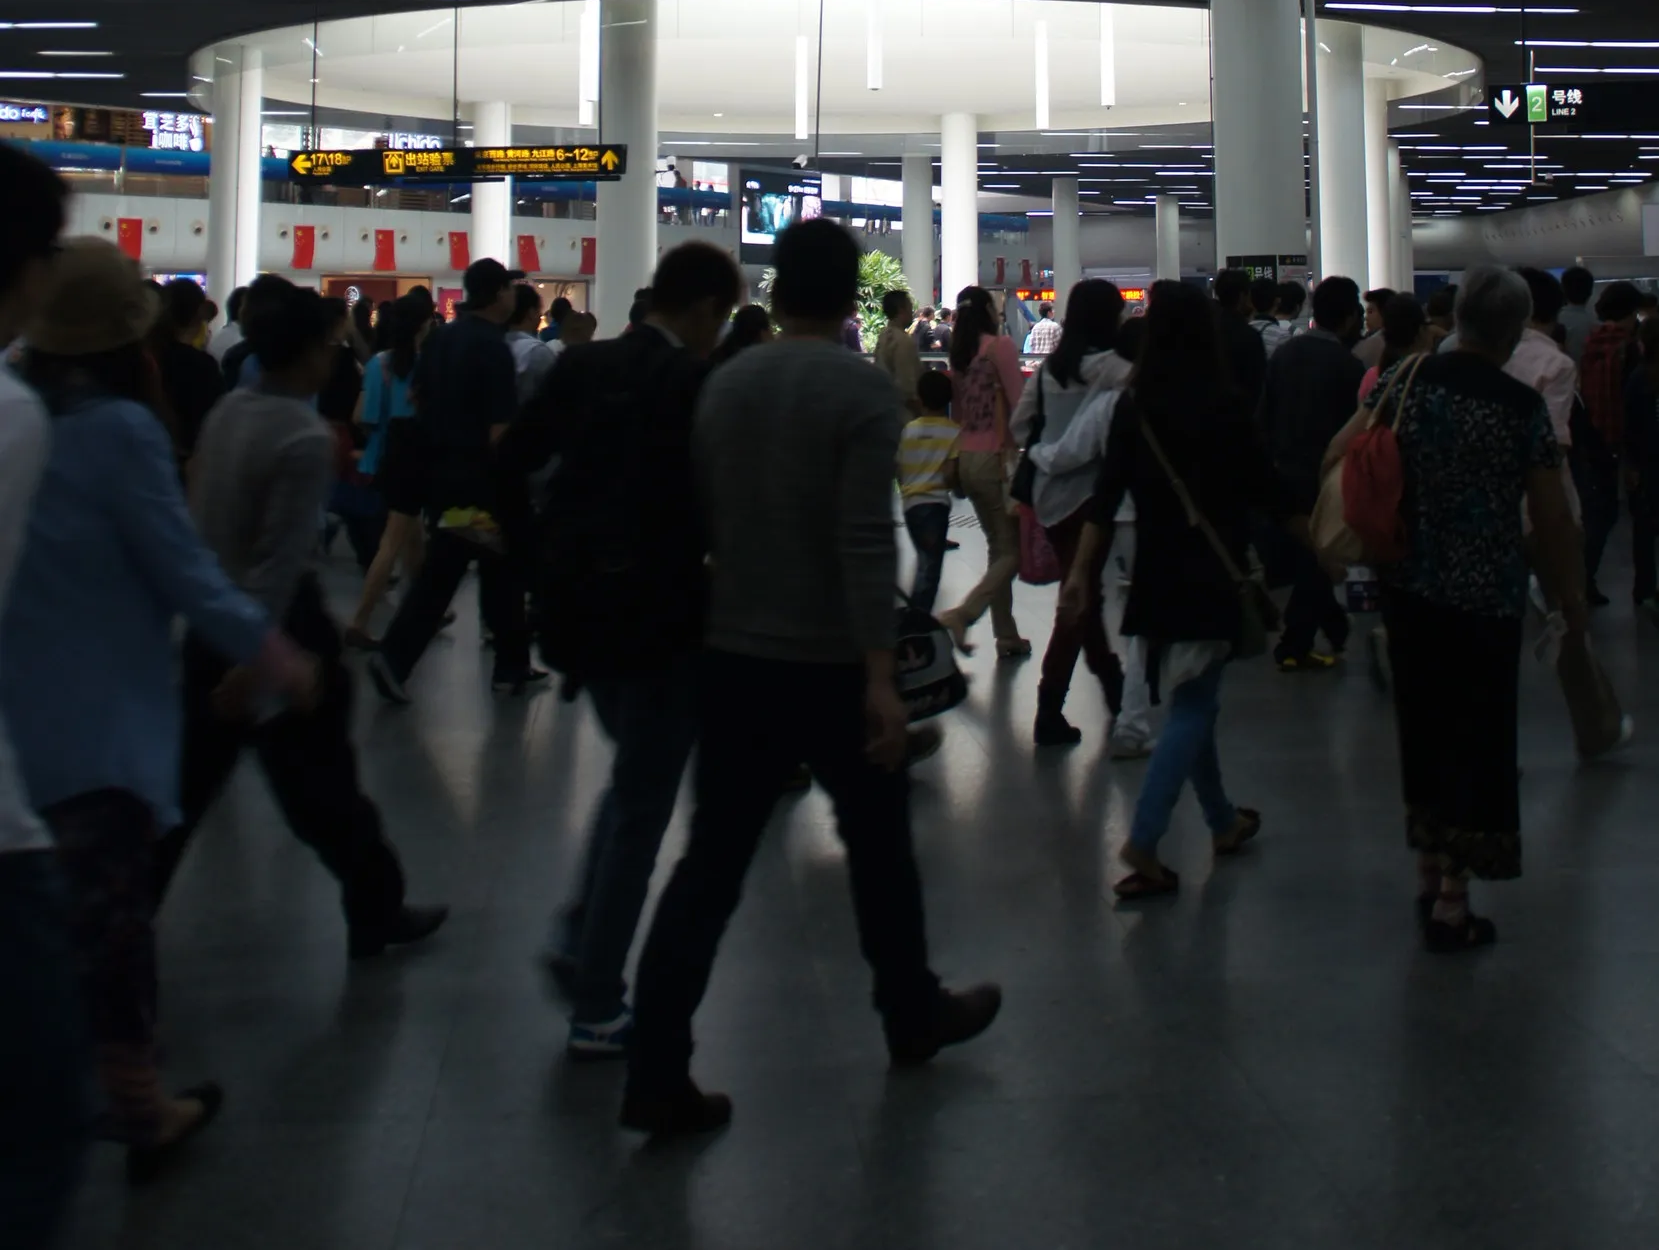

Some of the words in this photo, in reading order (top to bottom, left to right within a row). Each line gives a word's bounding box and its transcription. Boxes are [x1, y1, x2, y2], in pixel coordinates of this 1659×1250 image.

[1531, 96, 1543, 112] 2
[1552, 89, 1583, 105] 号线
[1552, 108, 1569, 116] LINE
[1571, 108, 1576, 116] 2
[142, 111, 190, 132] 宜芝多
[405, 152, 456, 166] 出站验票
[556, 148, 589, 161] 6~12
